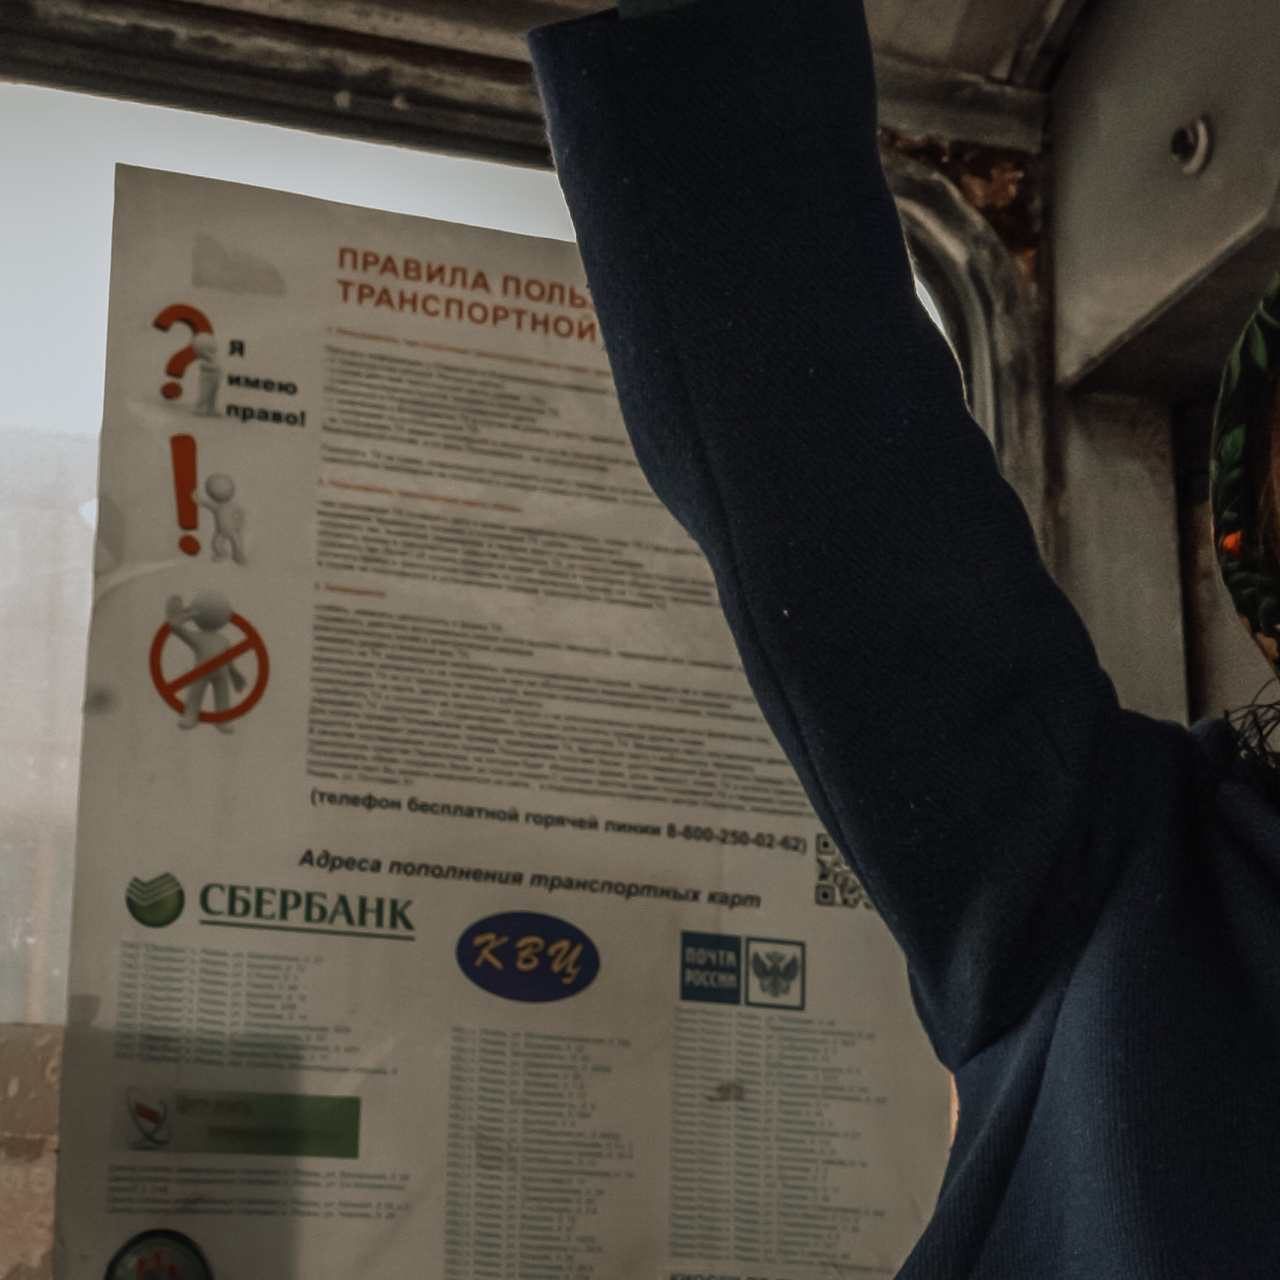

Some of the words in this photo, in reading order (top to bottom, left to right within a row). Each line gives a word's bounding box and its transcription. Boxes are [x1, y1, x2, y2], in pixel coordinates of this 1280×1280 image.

[338, 246, 491, 293] ПРАВИЛА
[502, 274, 594, 310] ПОЛЬ
[338, 280, 597, 343] ТРАНСПОРТНОЙ
[228, 338, 245, 357] Я
[227, 374, 297, 396] имею
[226, 404, 305, 427] право!
[310, 787, 401, 811] (телефон
[406, 796, 519, 823] бесплатной
[525, 811, 598, 830] горячей
[298, 849, 382, 873] Адреса
[388, 859, 524, 887] пополнения
[529, 872, 701, 903] транспортных
[707, 892, 762, 910] карт
[199, 882, 415, 931] СБЕРБАНК
[684, 947, 737, 968] ПОЧТА
